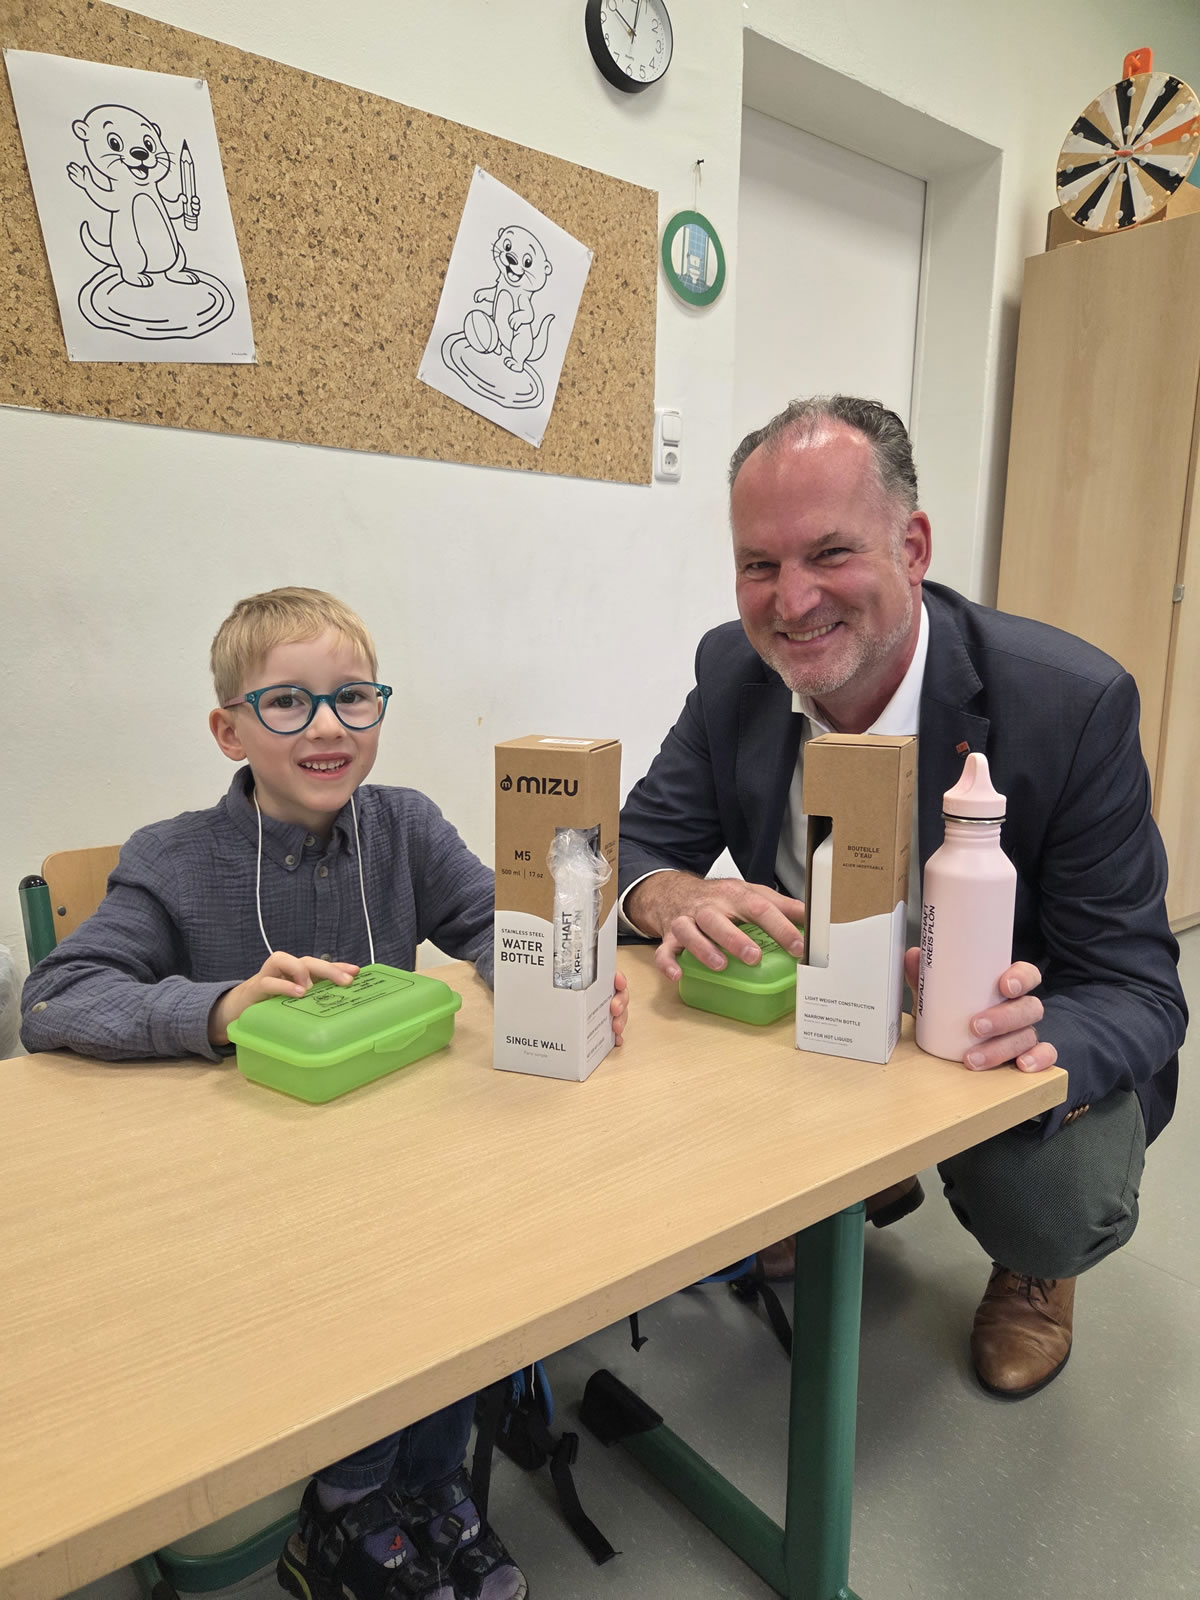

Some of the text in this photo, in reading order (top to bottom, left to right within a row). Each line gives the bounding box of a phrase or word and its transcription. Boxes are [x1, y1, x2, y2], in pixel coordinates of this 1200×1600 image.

[652, 18, 658, 34] 2
[656, 40, 662, 54] 3
[614, 52, 620, 64] 7
[648, 56, 656, 70] 4
[626, 64, 632, 76] 6
[640, 64, 646, 79] 5
[516, 776, 578, 796] MIZU
[514, 850, 531, 861] M5
[848, 845, 880, 854] BOUTEILLE
[502, 938, 543, 952] WATER
[926, 936, 934, 968] KREIS
[501, 951, 545, 966] BOTTLE
[838, 1000, 875, 1010] CONSTRUCTION
[506, 1035, 566, 1052] SINGLE WALL
